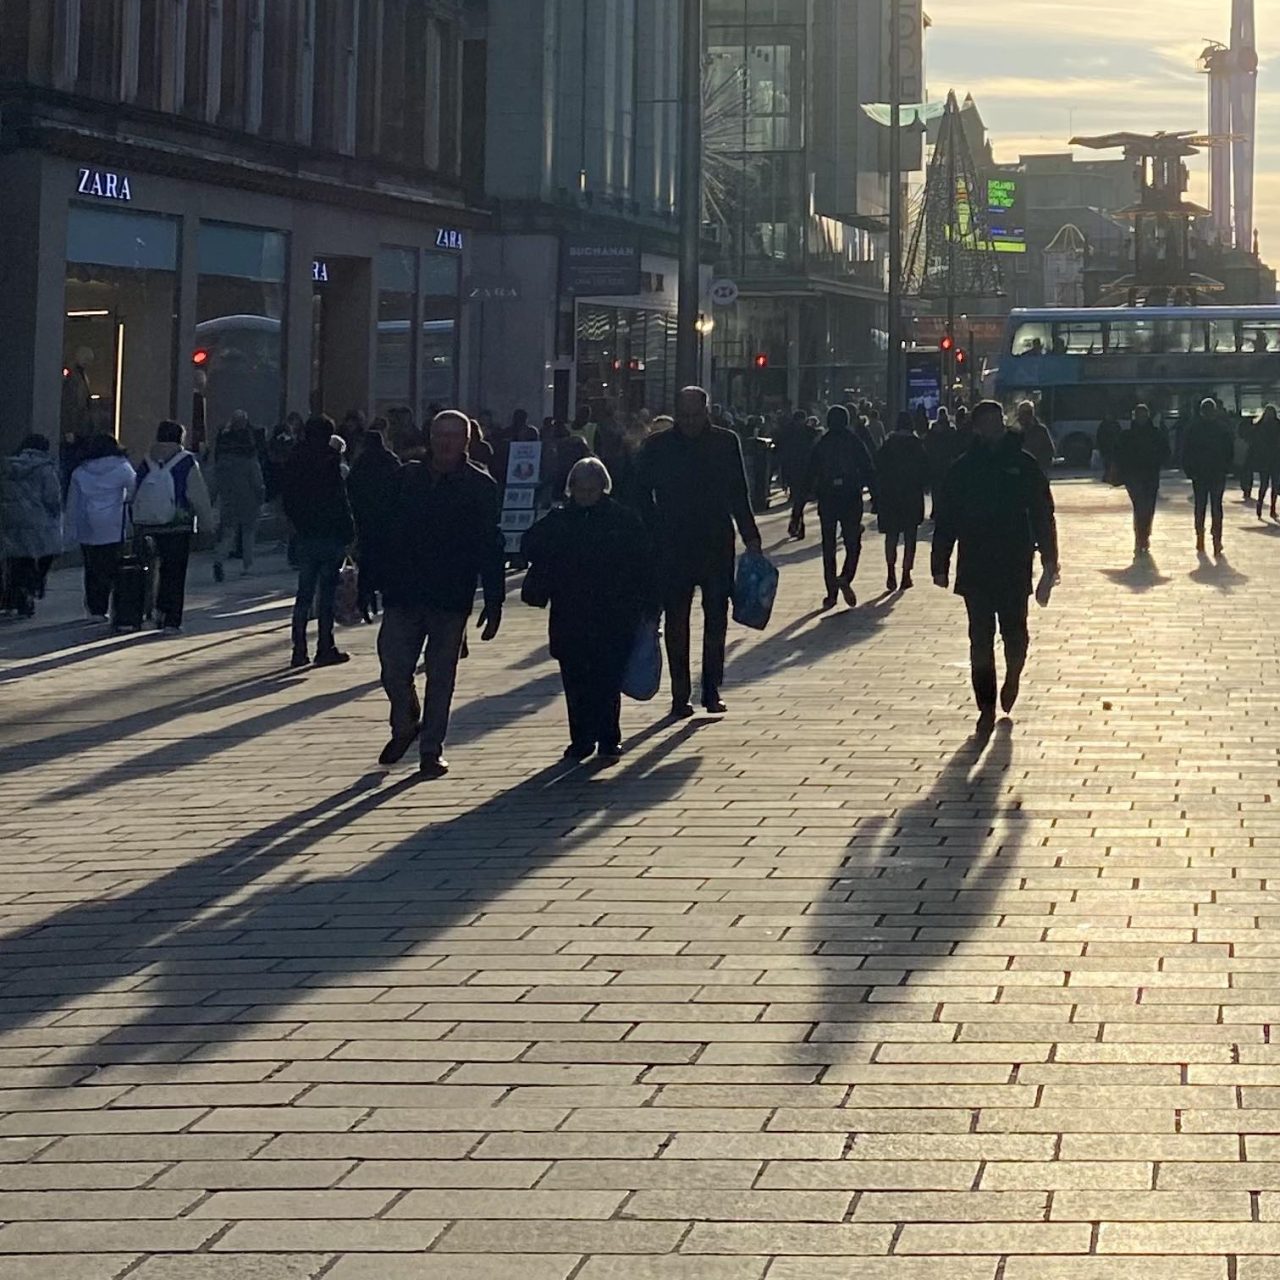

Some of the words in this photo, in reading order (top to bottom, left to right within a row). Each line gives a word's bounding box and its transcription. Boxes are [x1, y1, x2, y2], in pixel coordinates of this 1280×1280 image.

[78, 168, 132, 200] ZARA
[436, 227, 464, 250] ZARA
[569, 247, 635, 257] BUCHANAN
[312, 261, 329, 281] RA
